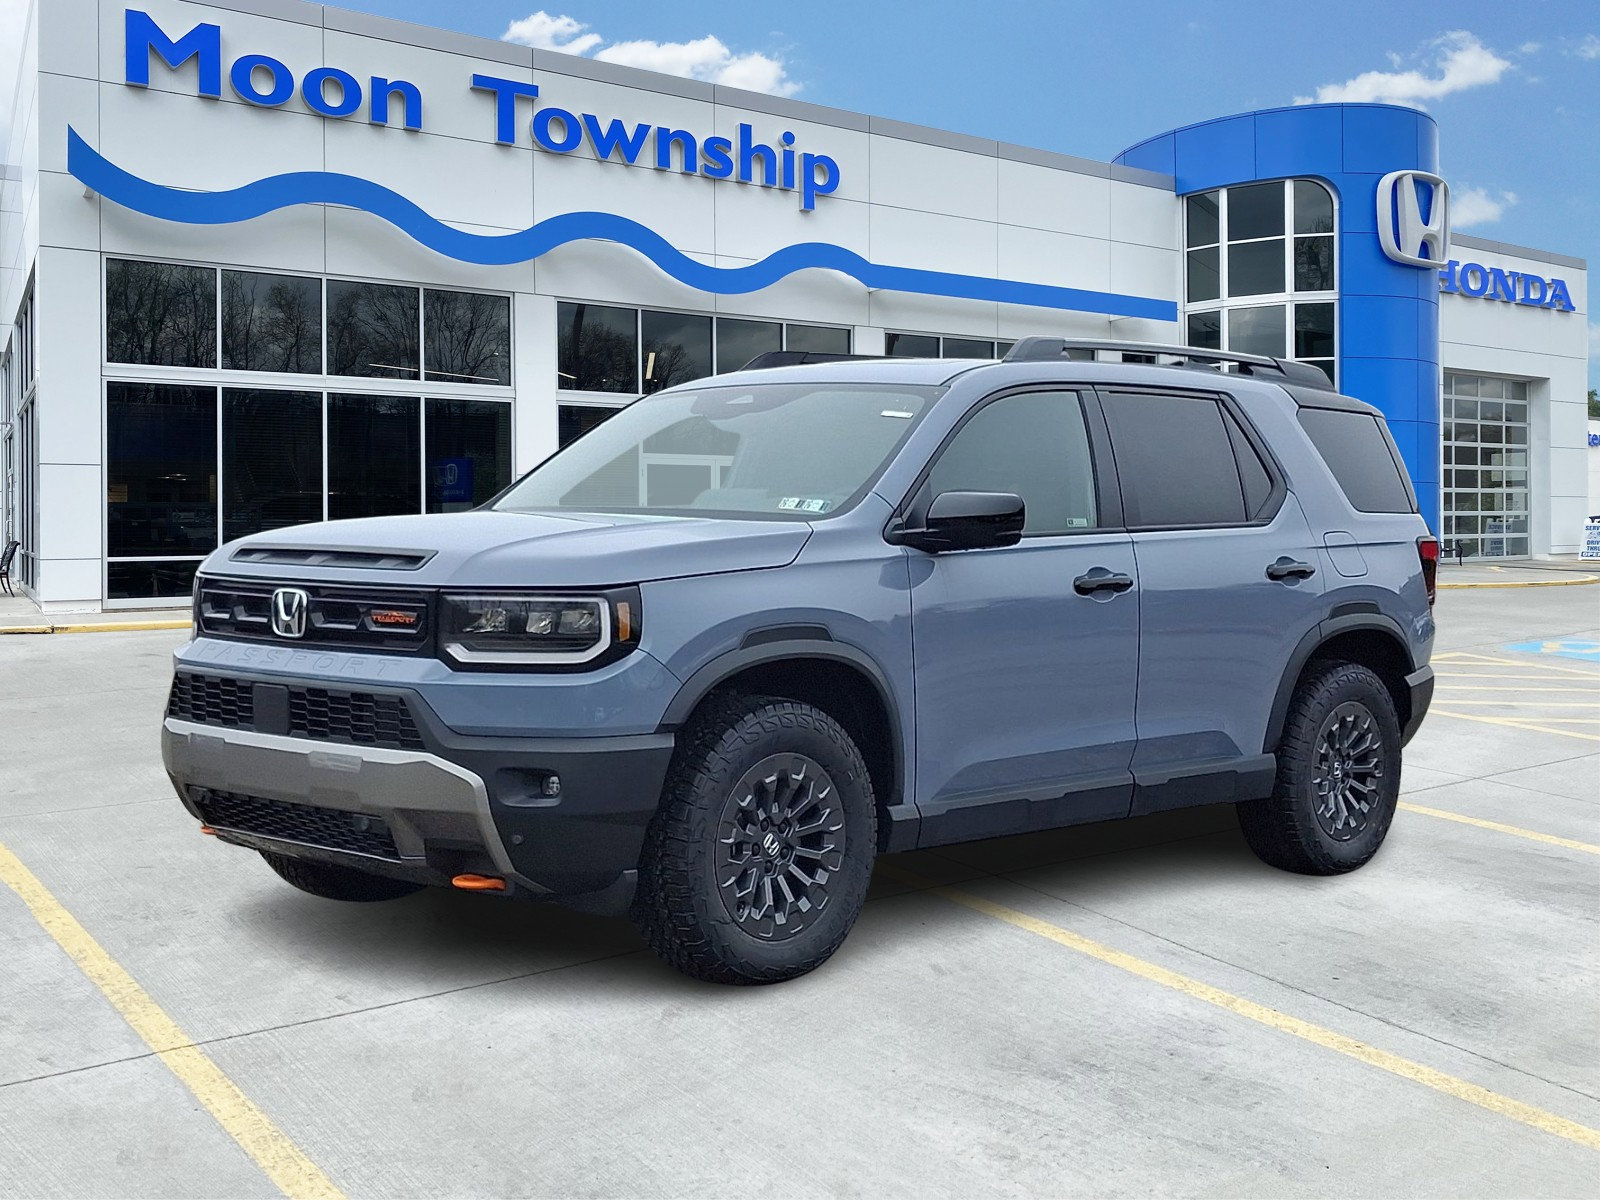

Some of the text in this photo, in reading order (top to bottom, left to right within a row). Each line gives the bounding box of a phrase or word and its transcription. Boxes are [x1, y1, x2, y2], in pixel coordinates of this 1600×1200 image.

[125, 9, 840, 212] Moon Township
[196, 642, 403, 677] PASSPORT
